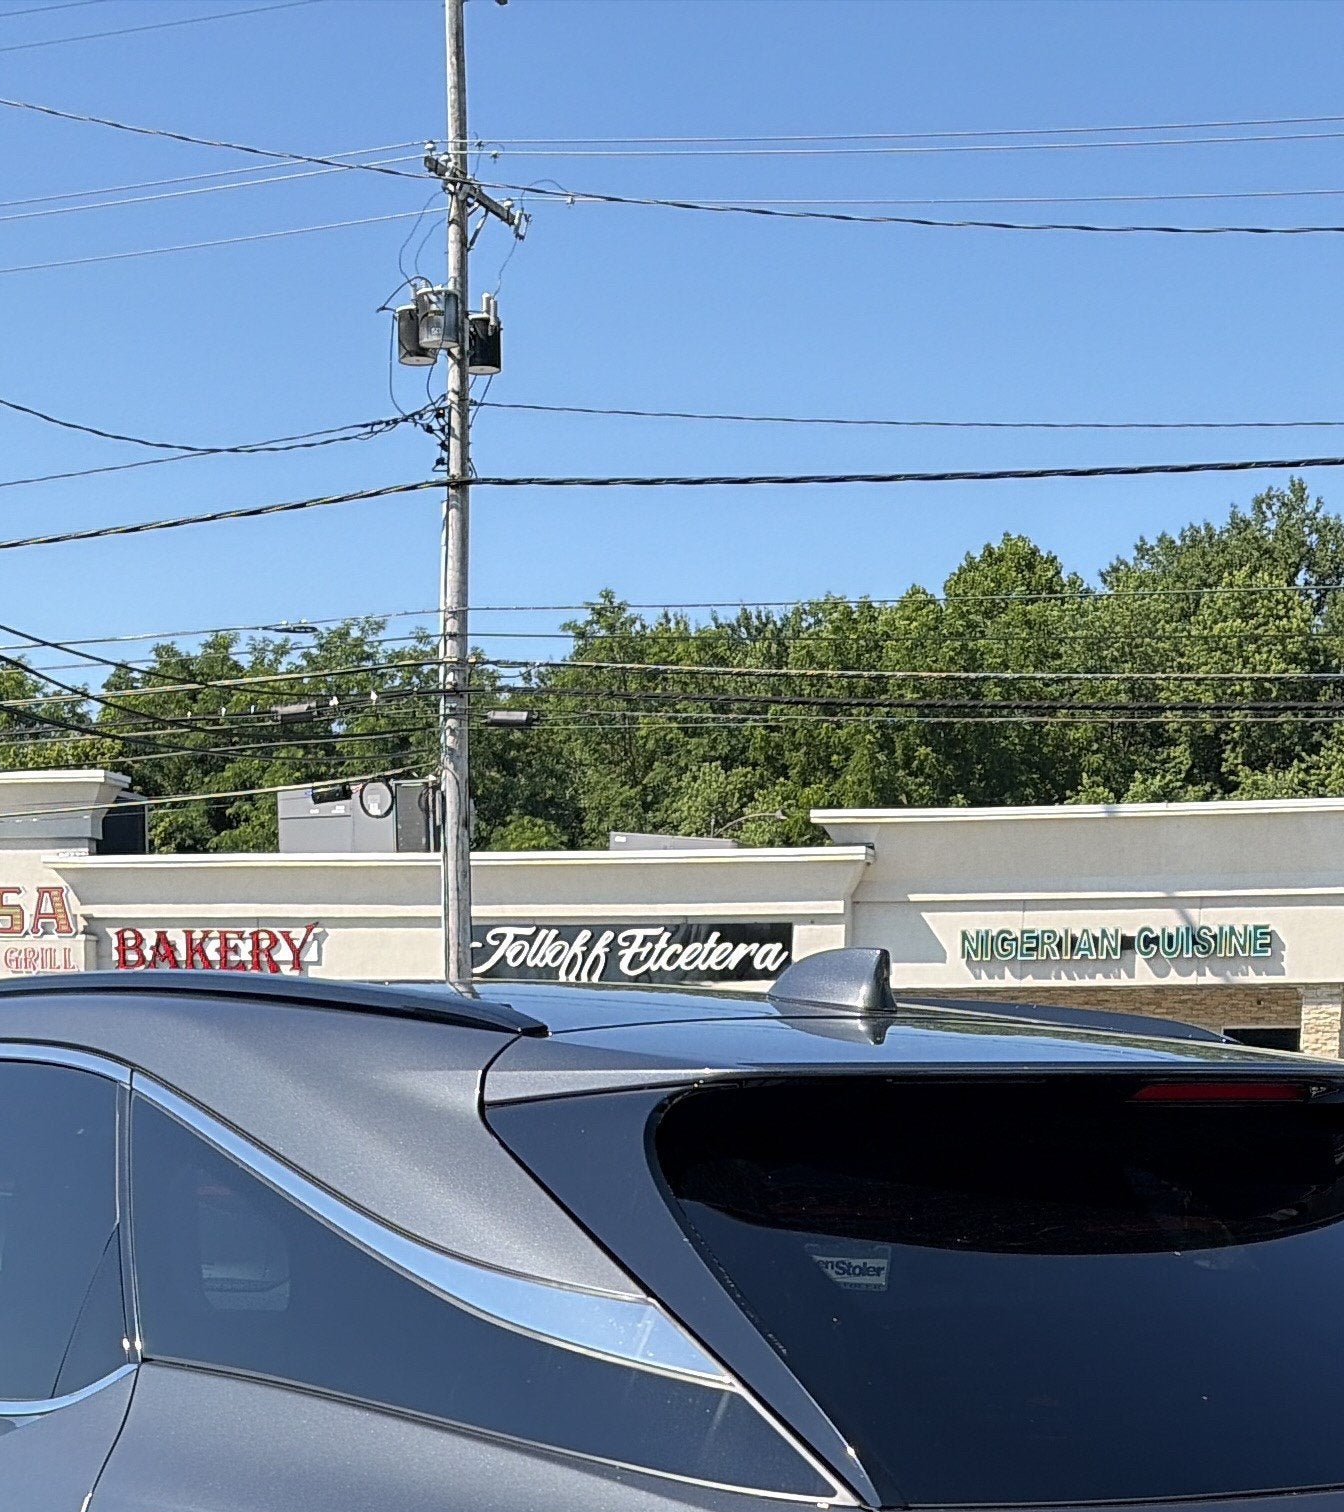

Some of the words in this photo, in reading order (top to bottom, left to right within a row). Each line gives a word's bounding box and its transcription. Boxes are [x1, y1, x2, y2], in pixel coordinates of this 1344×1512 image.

[5, 946, 77, 971] GRILL
[116, 921, 320, 974] BAKERY
[619, 926, 789, 976] Etcetera
[961, 927, 1121, 961] NIGERIAN
[1135, 923, 1272, 960] CUISINE
